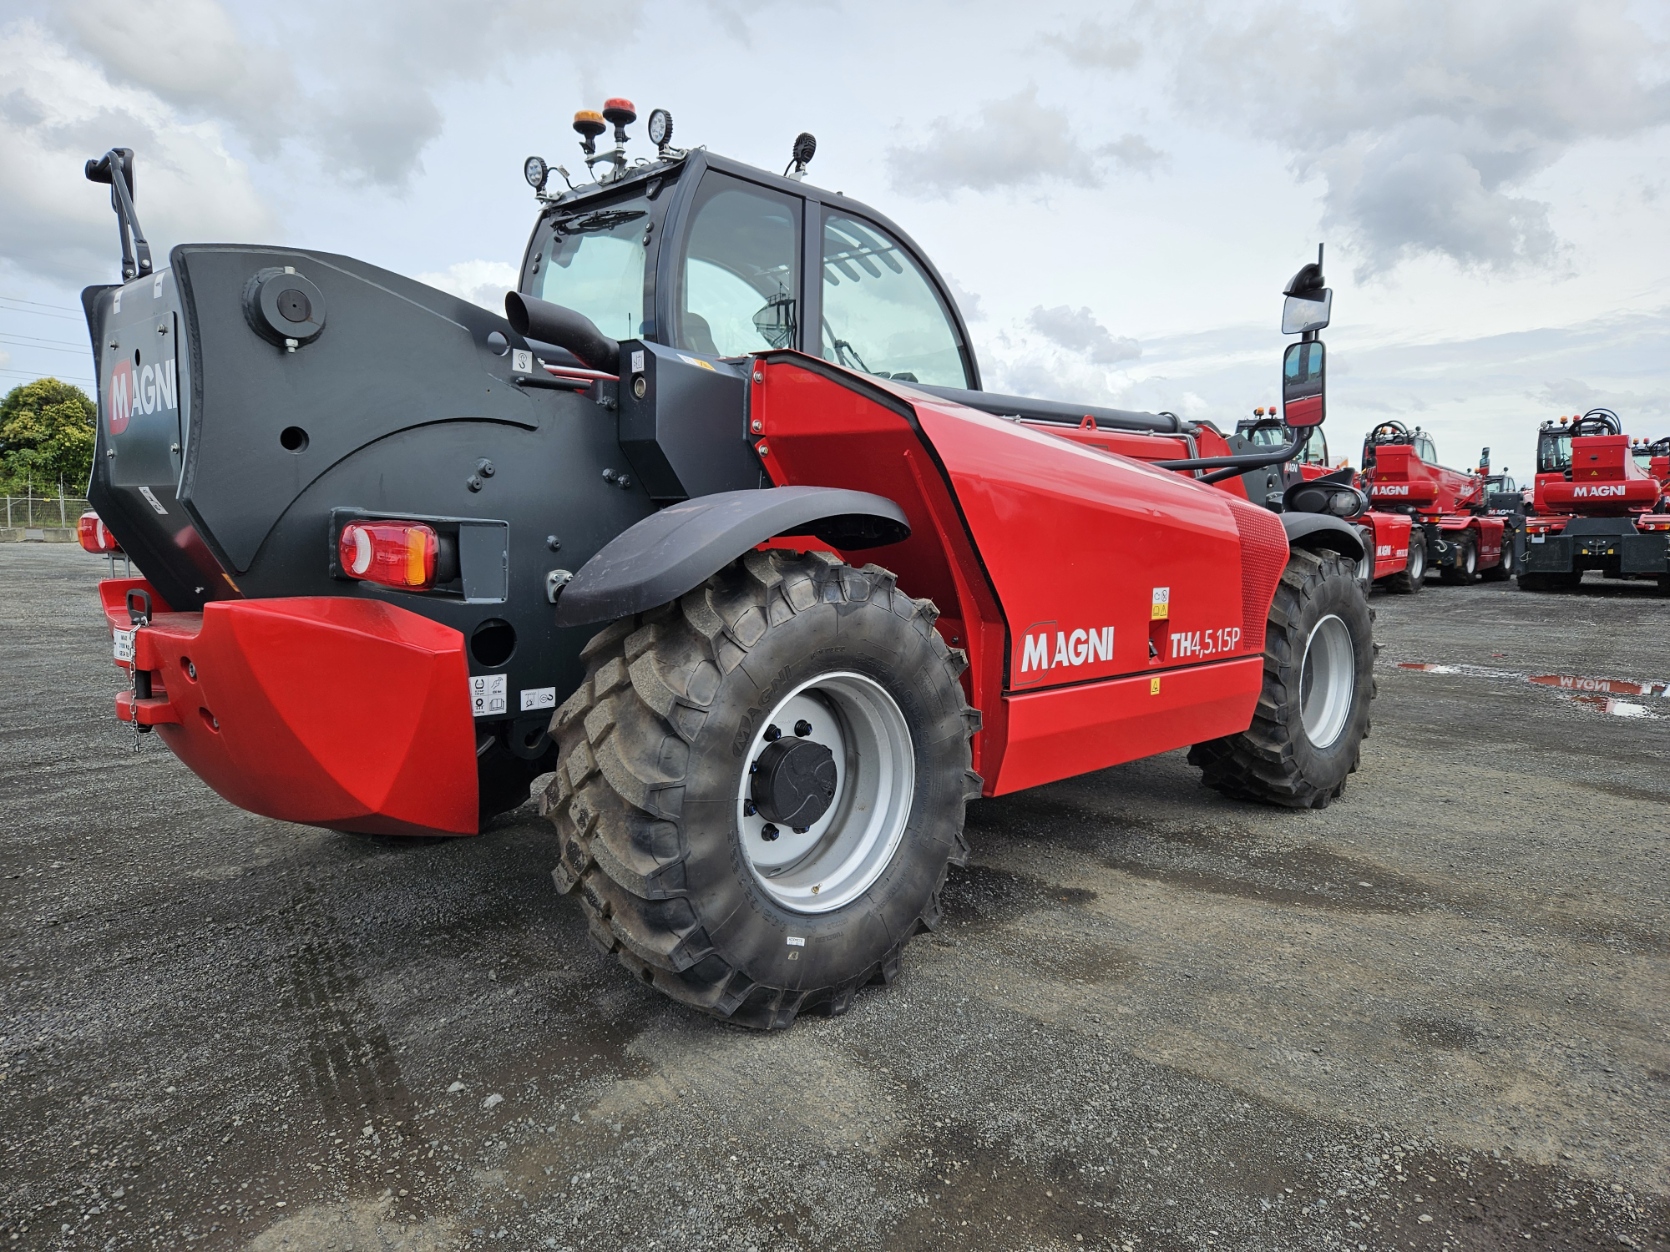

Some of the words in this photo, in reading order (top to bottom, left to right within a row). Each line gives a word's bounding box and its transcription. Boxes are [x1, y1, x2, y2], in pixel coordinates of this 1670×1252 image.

[112, 359, 177, 421] MAGNI
[1573, 485, 1626, 497] MAGNI
[1021, 626, 1114, 672] MAGNI
[1171, 627, 1240, 659] TH4,5.15P
[733, 664, 793, 758] MAGNI
